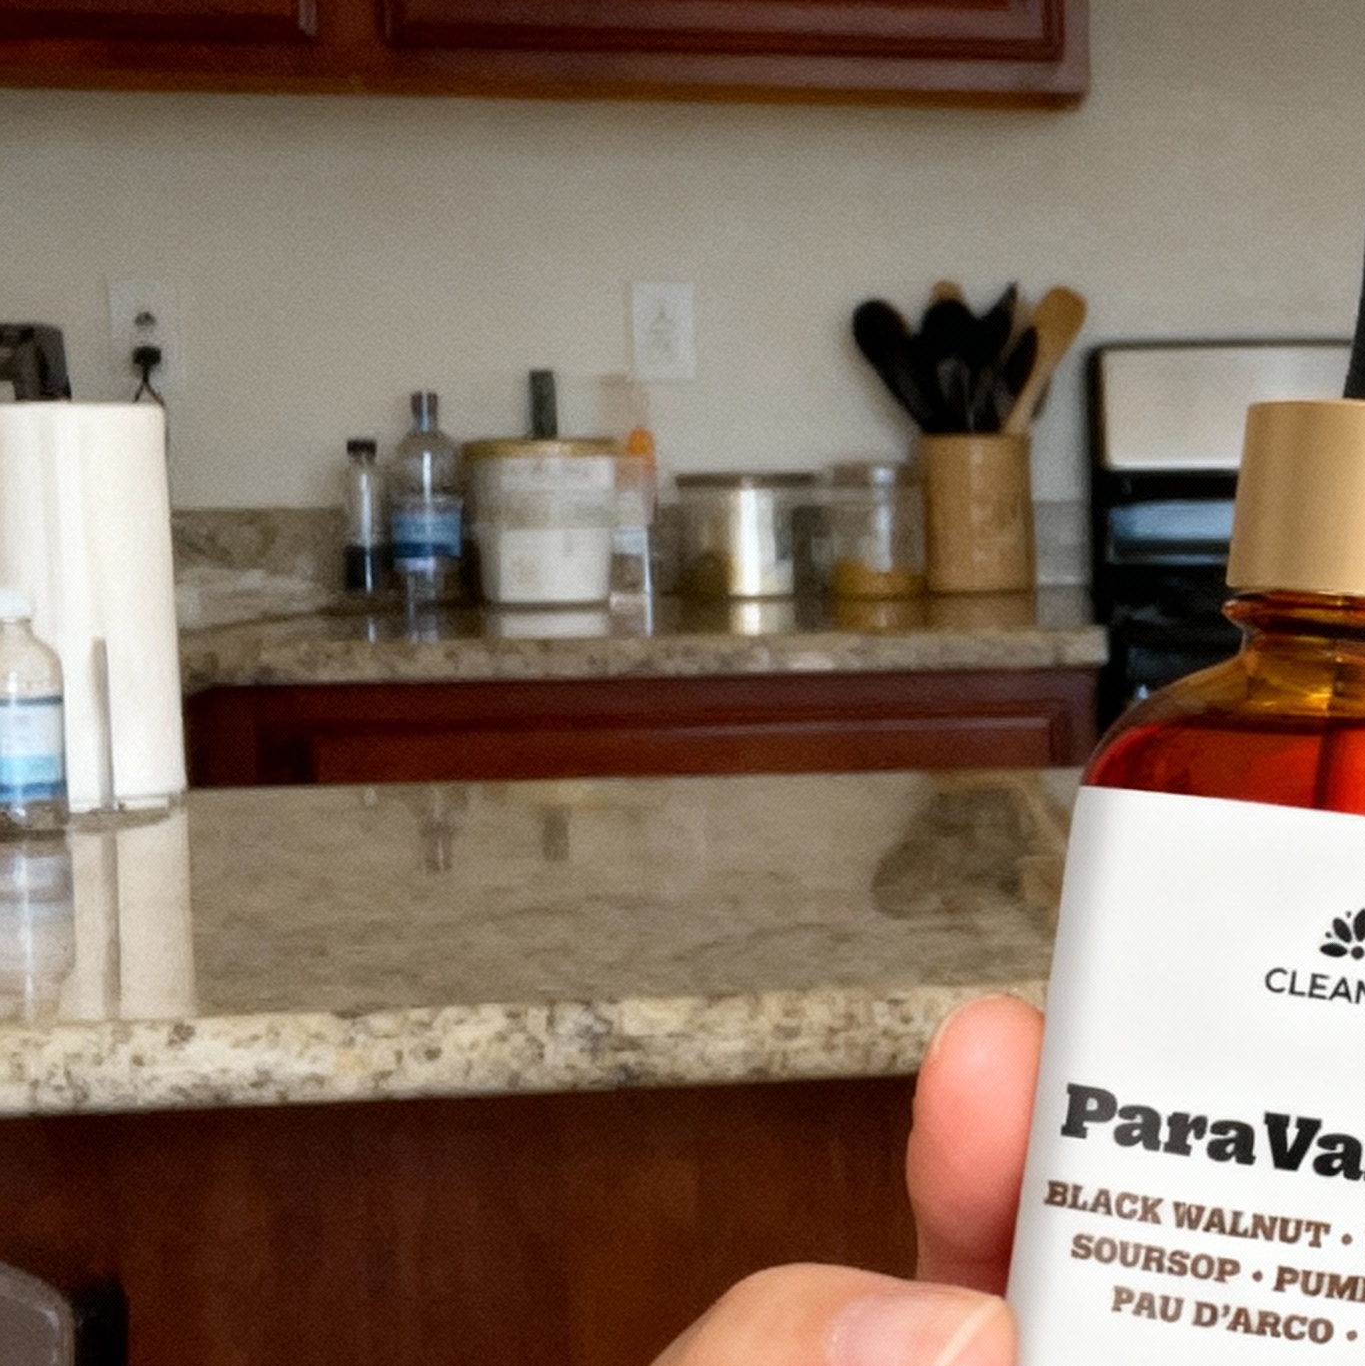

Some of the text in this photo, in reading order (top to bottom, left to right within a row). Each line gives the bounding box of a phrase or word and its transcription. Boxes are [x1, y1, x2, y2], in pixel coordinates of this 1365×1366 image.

[1041, 1178, 1164, 1225] BLACK
[1172, 1201, 1332, 1249] WALNUT
[1070, 1233, 1241, 1284] SOURSOP
[1111, 1285, 1184, 1323] PAU
[1191, 1300, 1335, 1345] D’ARCO
